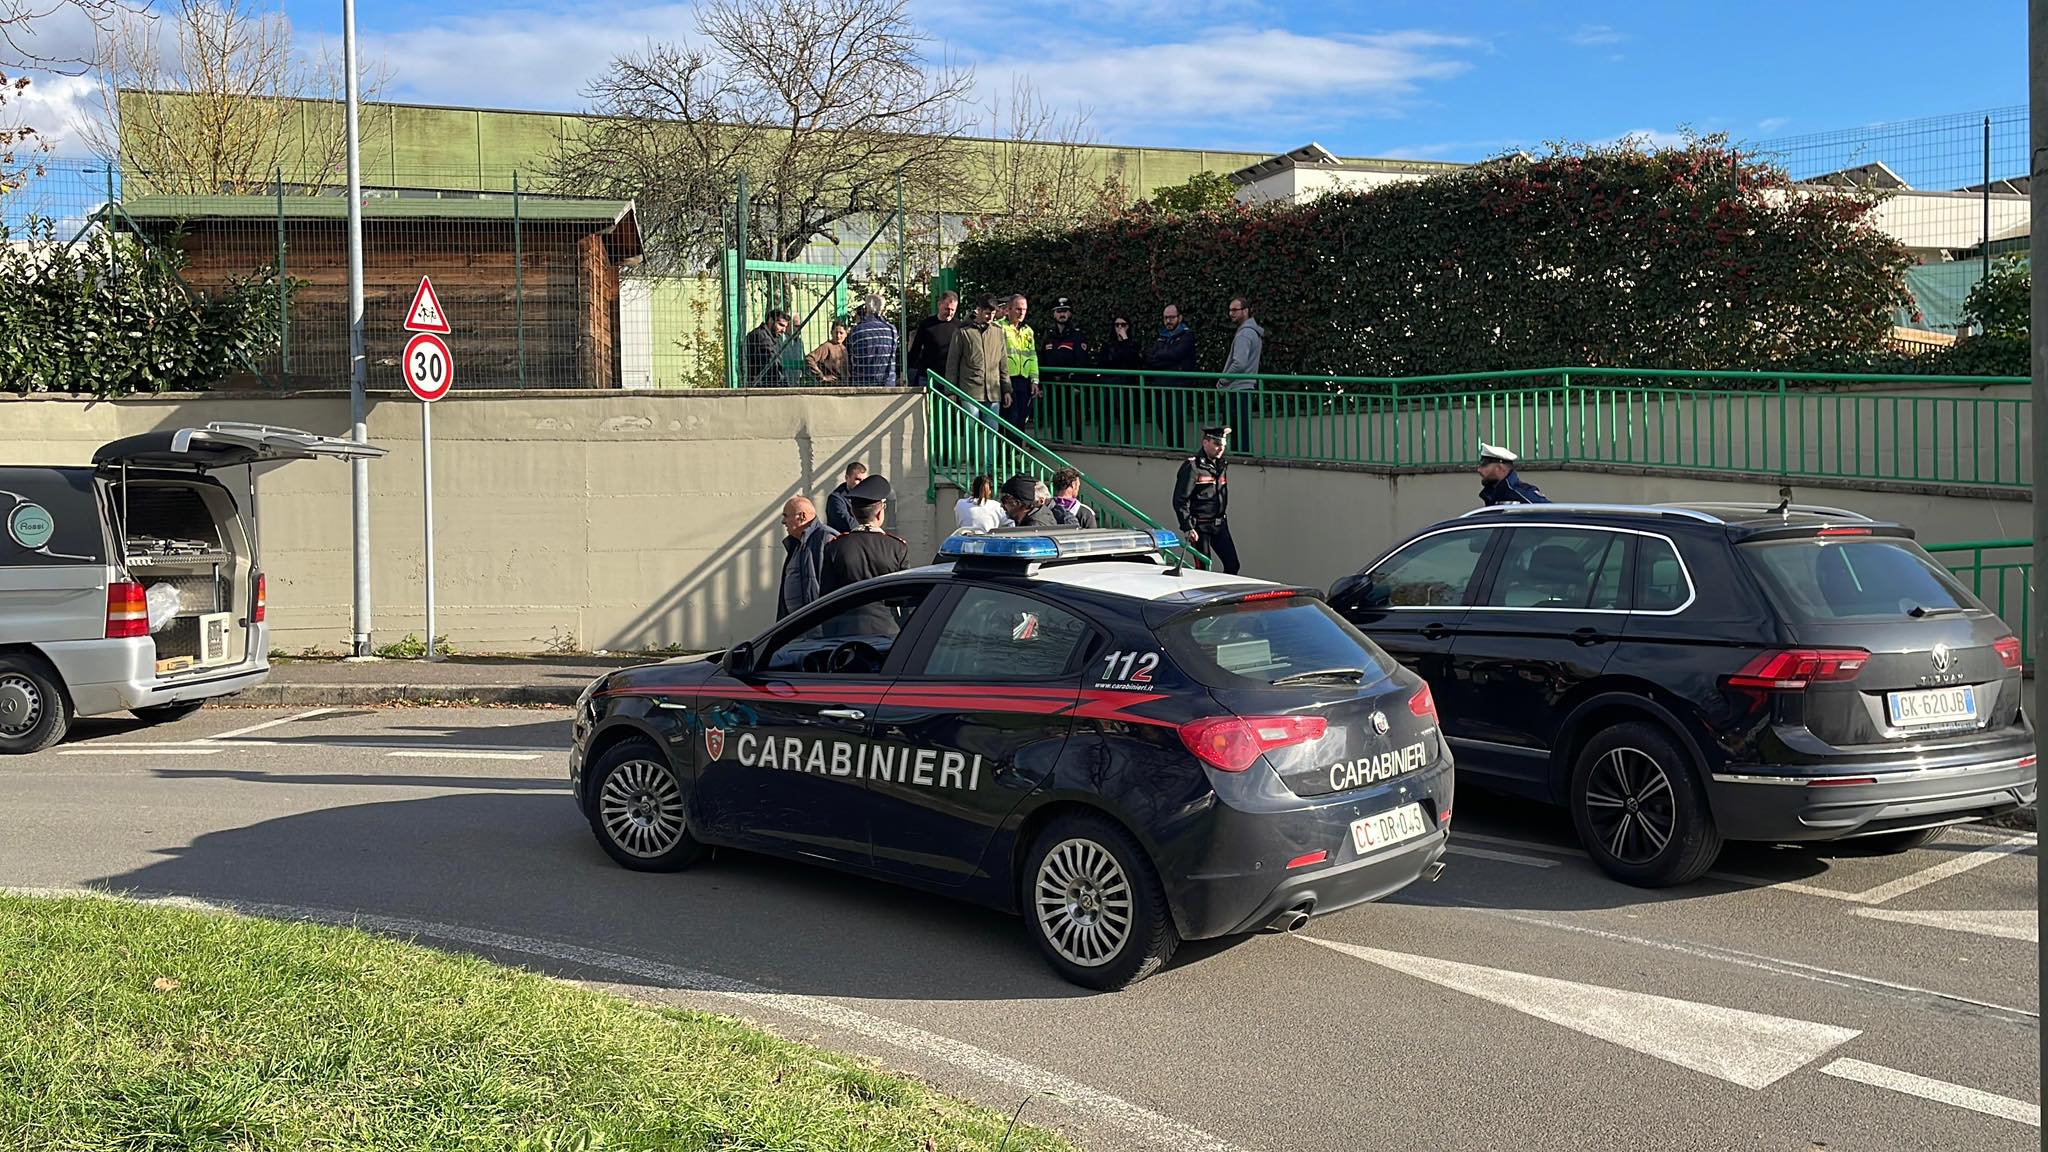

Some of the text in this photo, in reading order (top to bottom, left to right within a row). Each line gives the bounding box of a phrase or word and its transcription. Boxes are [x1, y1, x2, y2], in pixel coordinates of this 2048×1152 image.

[414, 352, 442, 383] 30
[20, 522, 44, 531] Rossi
[1102, 651, 1160, 682] 112
[1094, 682, 1154, 691] www.carabinieri.it
[737, 732, 982, 791] CARABINIERI
[1330, 741, 1426, 791] CARABINIERI
